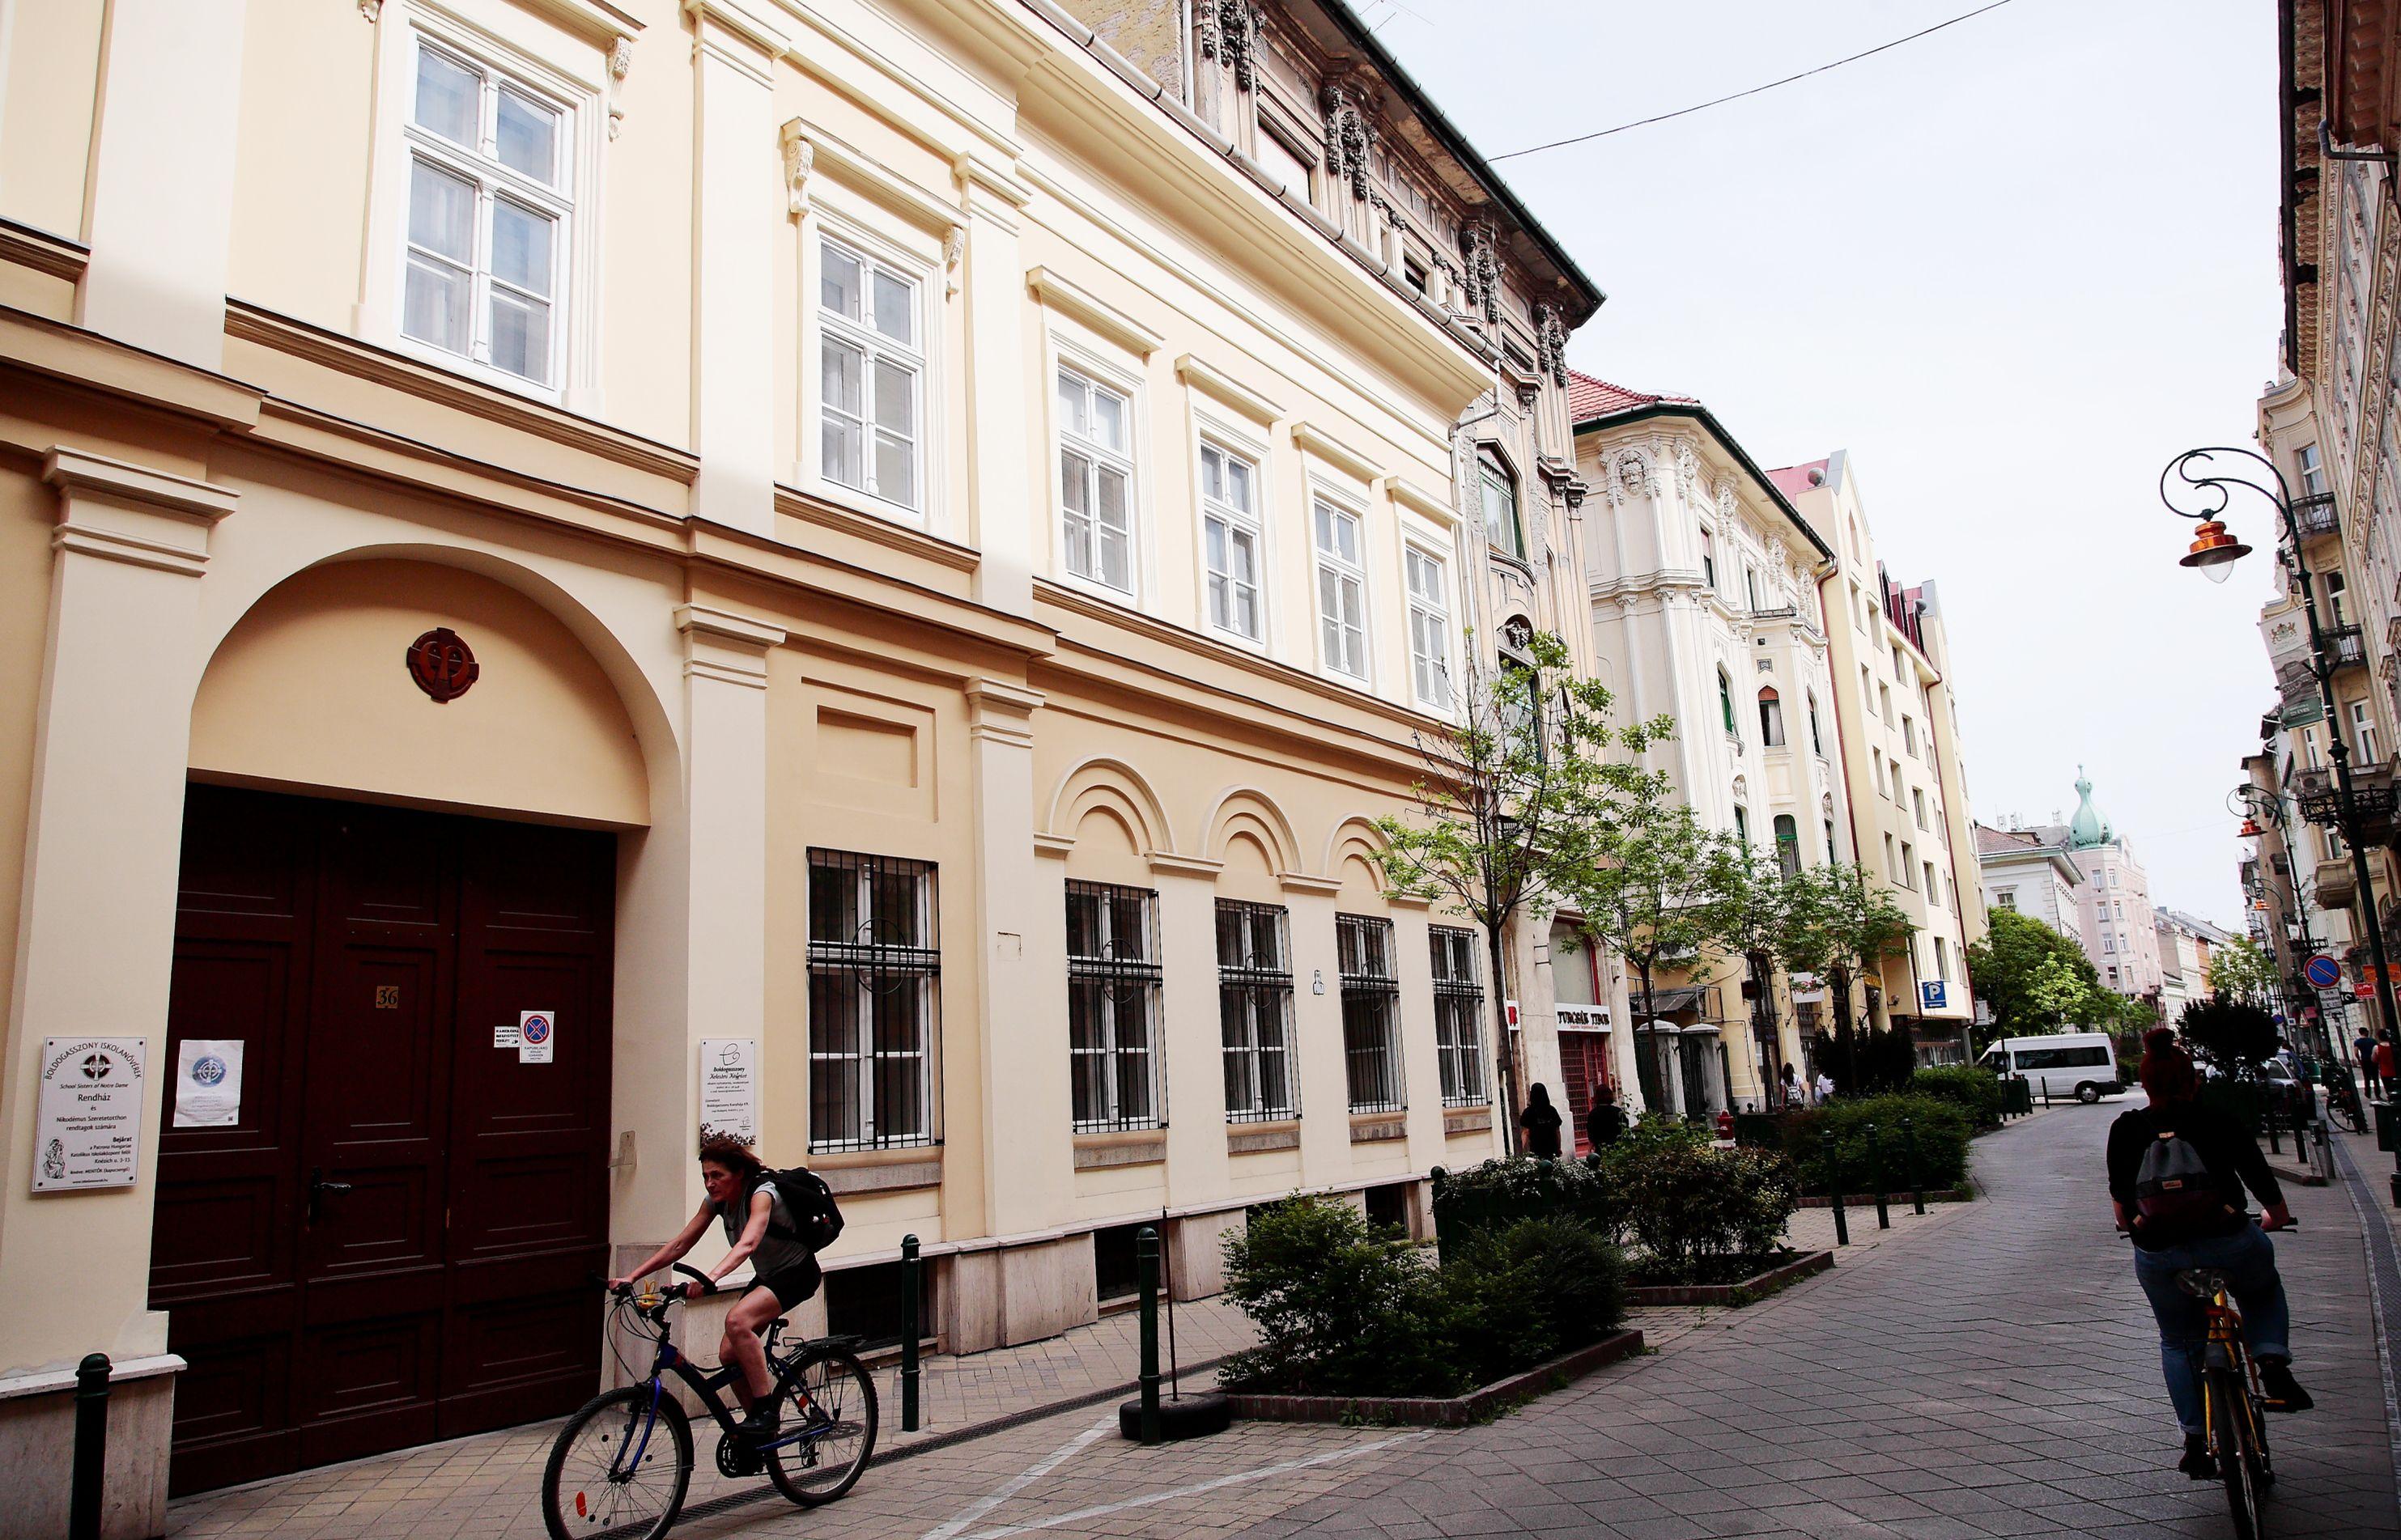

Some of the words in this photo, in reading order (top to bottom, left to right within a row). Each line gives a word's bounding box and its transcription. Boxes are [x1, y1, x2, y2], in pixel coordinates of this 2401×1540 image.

[376, 990, 397, 1005] 36
[45, 1042, 98, 1080] BOLDOGASSZONY
[100, 1042, 142, 1080] ISKOLANŐVÉREK
[78, 1092, 111, 1101] Rendház
